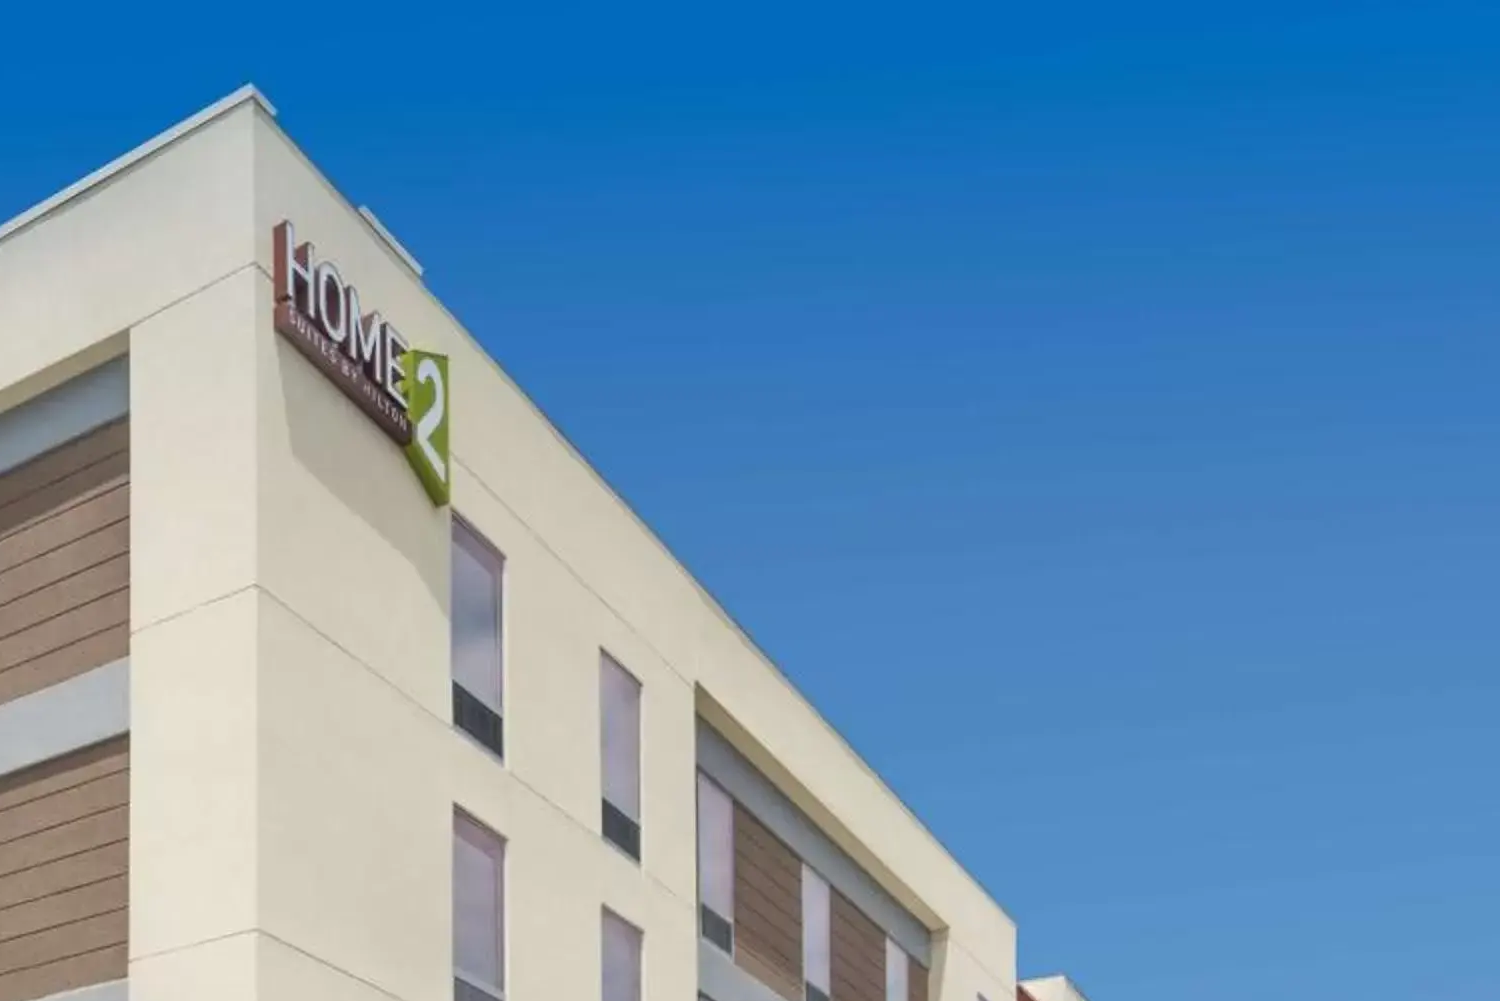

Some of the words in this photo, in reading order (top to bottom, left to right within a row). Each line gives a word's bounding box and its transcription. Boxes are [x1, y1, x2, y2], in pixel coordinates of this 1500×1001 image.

[285, 220, 408, 410] HOME
[416, 358, 446, 483] 2
[288, 306, 338, 364] SUITES
[341, 360, 360, 382] BY
[363, 383, 407, 431] HILTON
